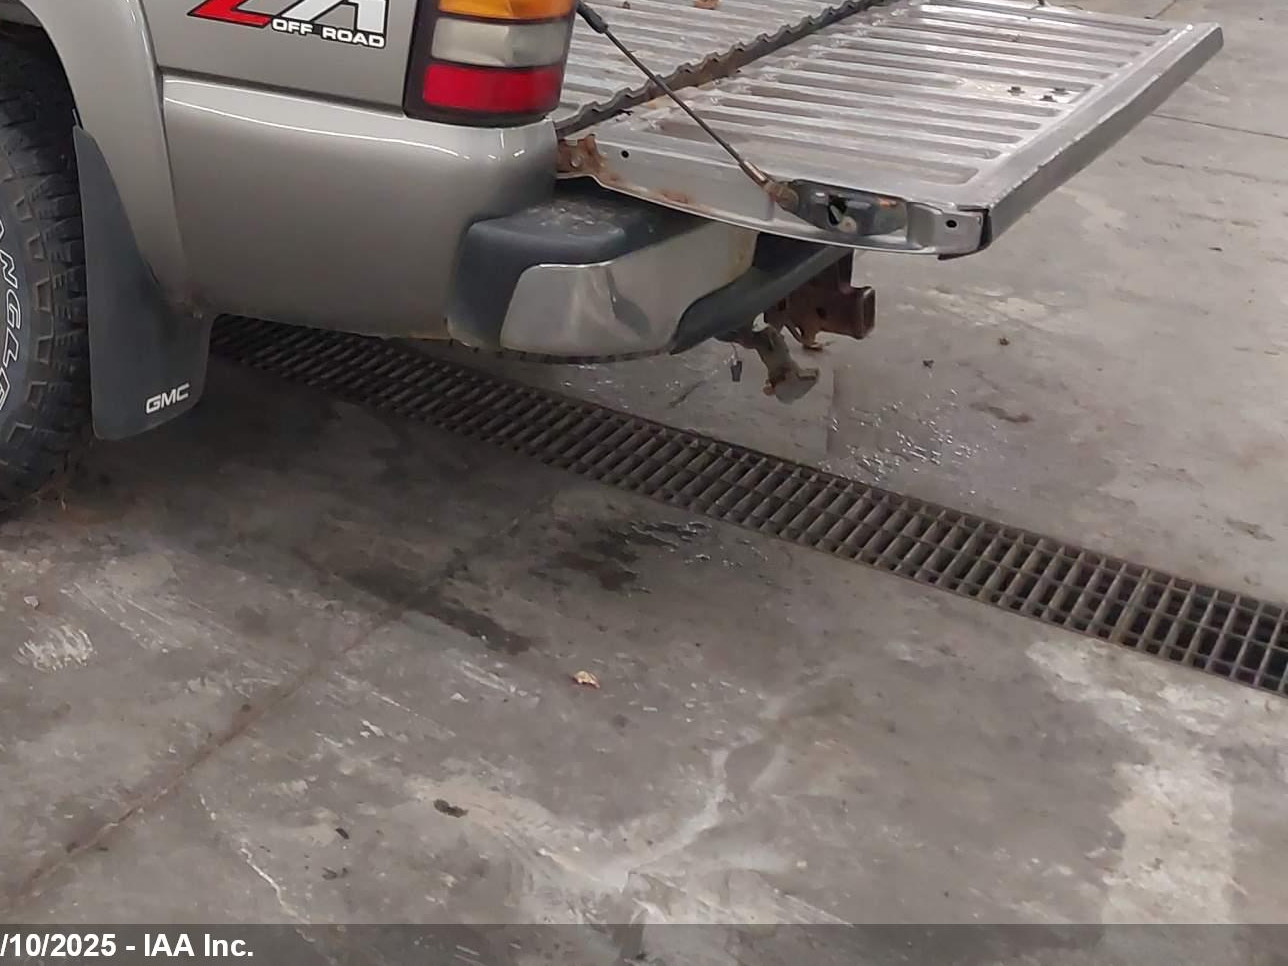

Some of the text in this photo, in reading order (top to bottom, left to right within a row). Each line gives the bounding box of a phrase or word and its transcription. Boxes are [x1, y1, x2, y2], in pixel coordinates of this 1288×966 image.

[271, 18, 386, 49] OFF ROAD
[145, 382, 191, 414] GMC
